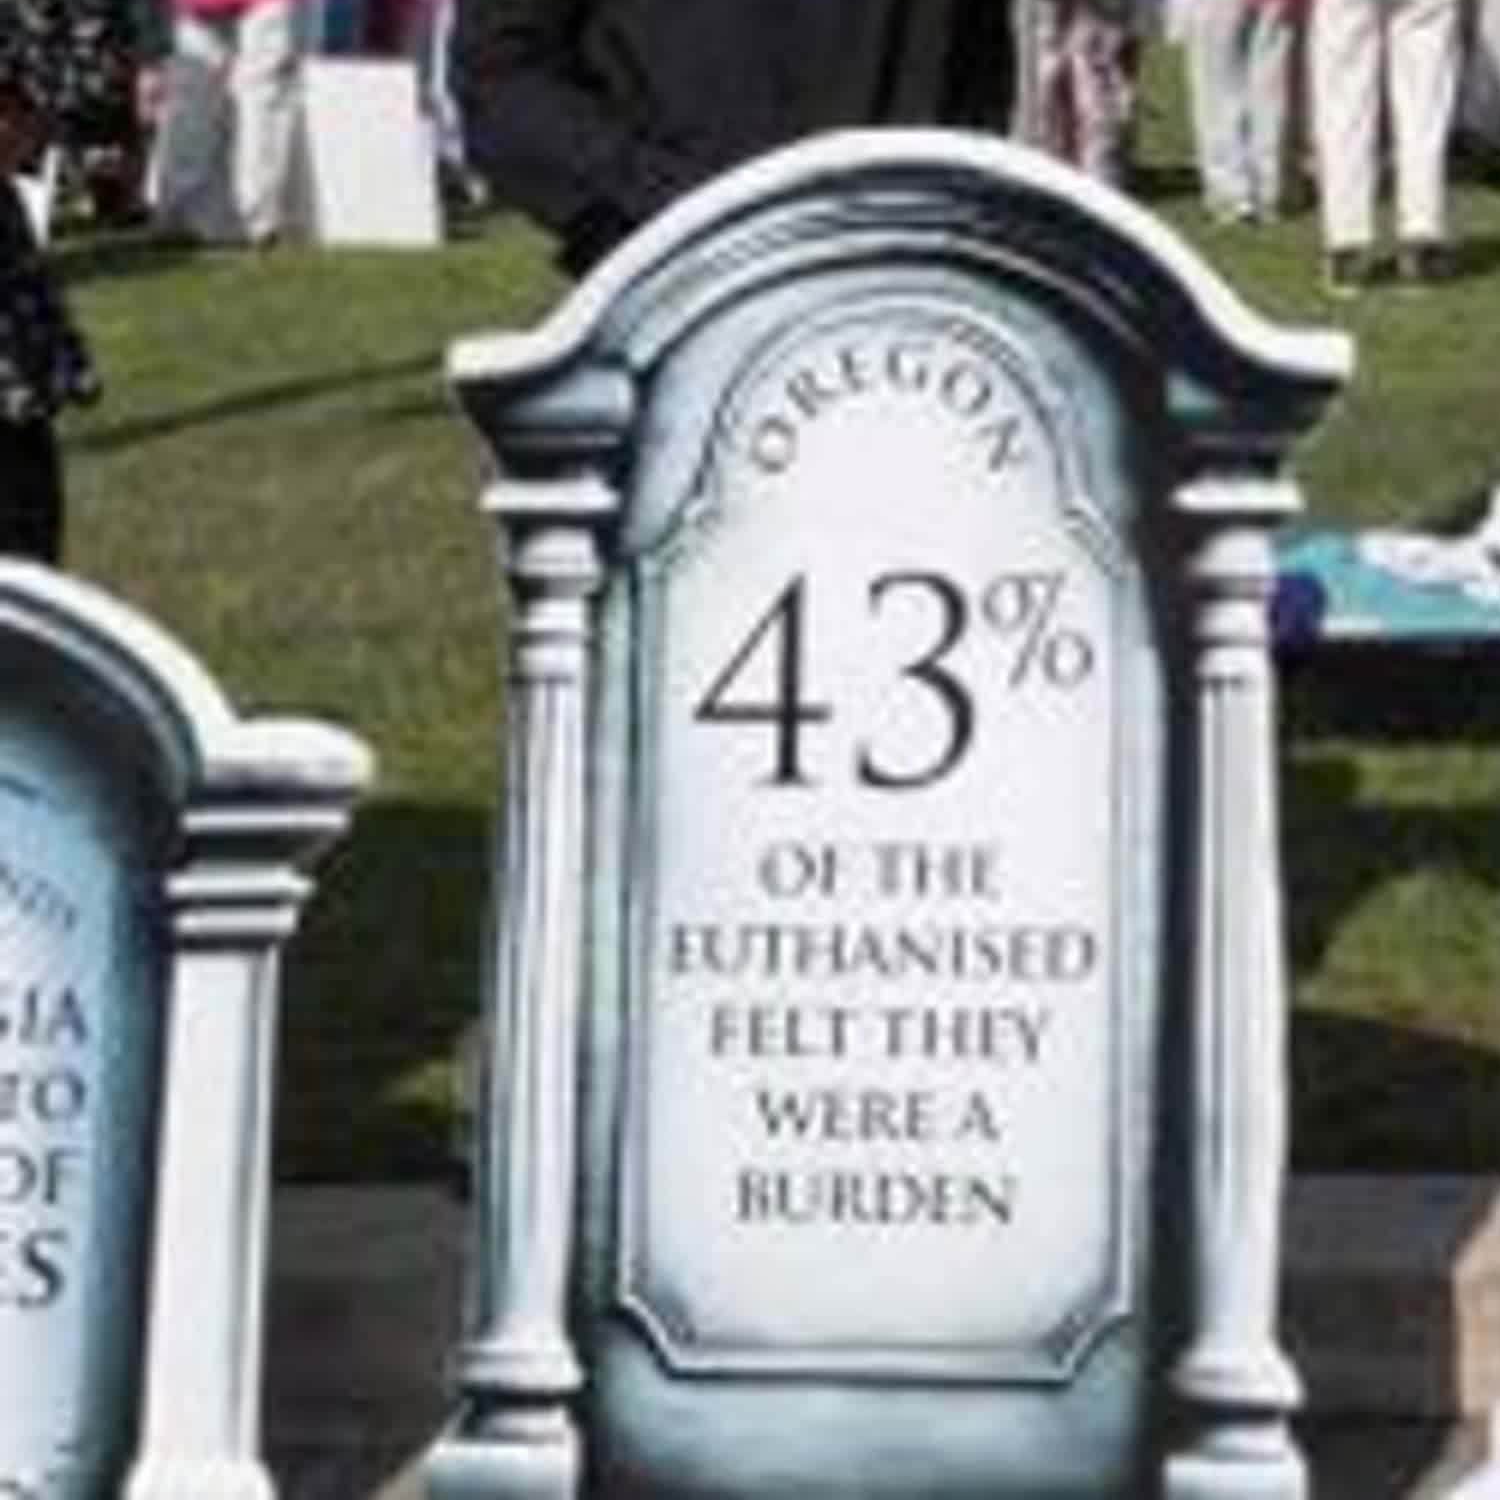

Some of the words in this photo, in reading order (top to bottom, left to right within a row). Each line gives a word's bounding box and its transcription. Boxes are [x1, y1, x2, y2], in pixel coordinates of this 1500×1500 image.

[750, 346, 1030, 473] OREGON
[693, 571, 1095, 793] 43%
[758, 842, 838, 898] OF
[874, 842, 1001, 897] THE
[670, 924, 1098, 980] EUTHANISED
[709, 1006, 858, 1059] FELT
[877, 1006, 1052, 1062] THEY
[756, 1090, 934, 1141] WERE
[953, 1090, 1000, 1141] A
[735, 1170, 1017, 1226] BURDEN
